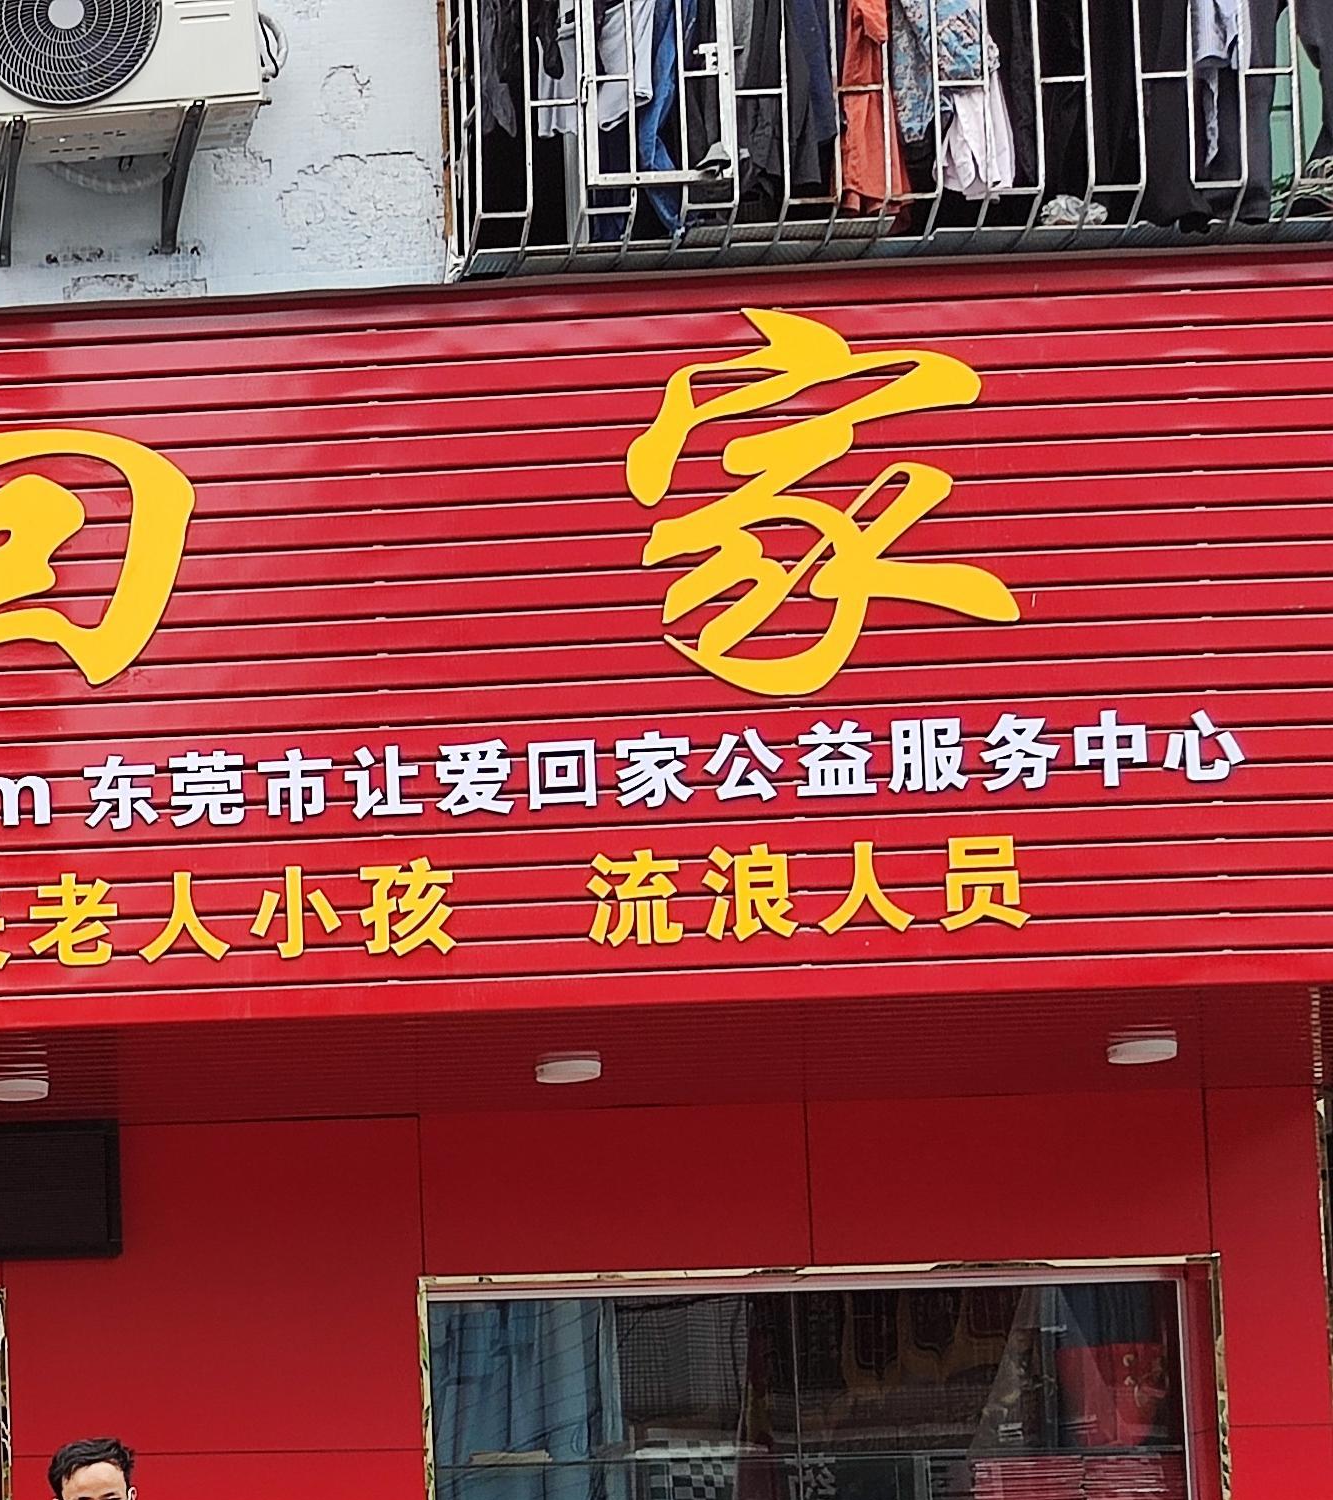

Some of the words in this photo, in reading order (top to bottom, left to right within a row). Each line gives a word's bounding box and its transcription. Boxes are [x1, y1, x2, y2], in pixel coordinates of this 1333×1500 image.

[83, 707, 1245, 831] 东莞市让爱回家公益服务中心
[588, 834, 1031, 948] 流浪人员
